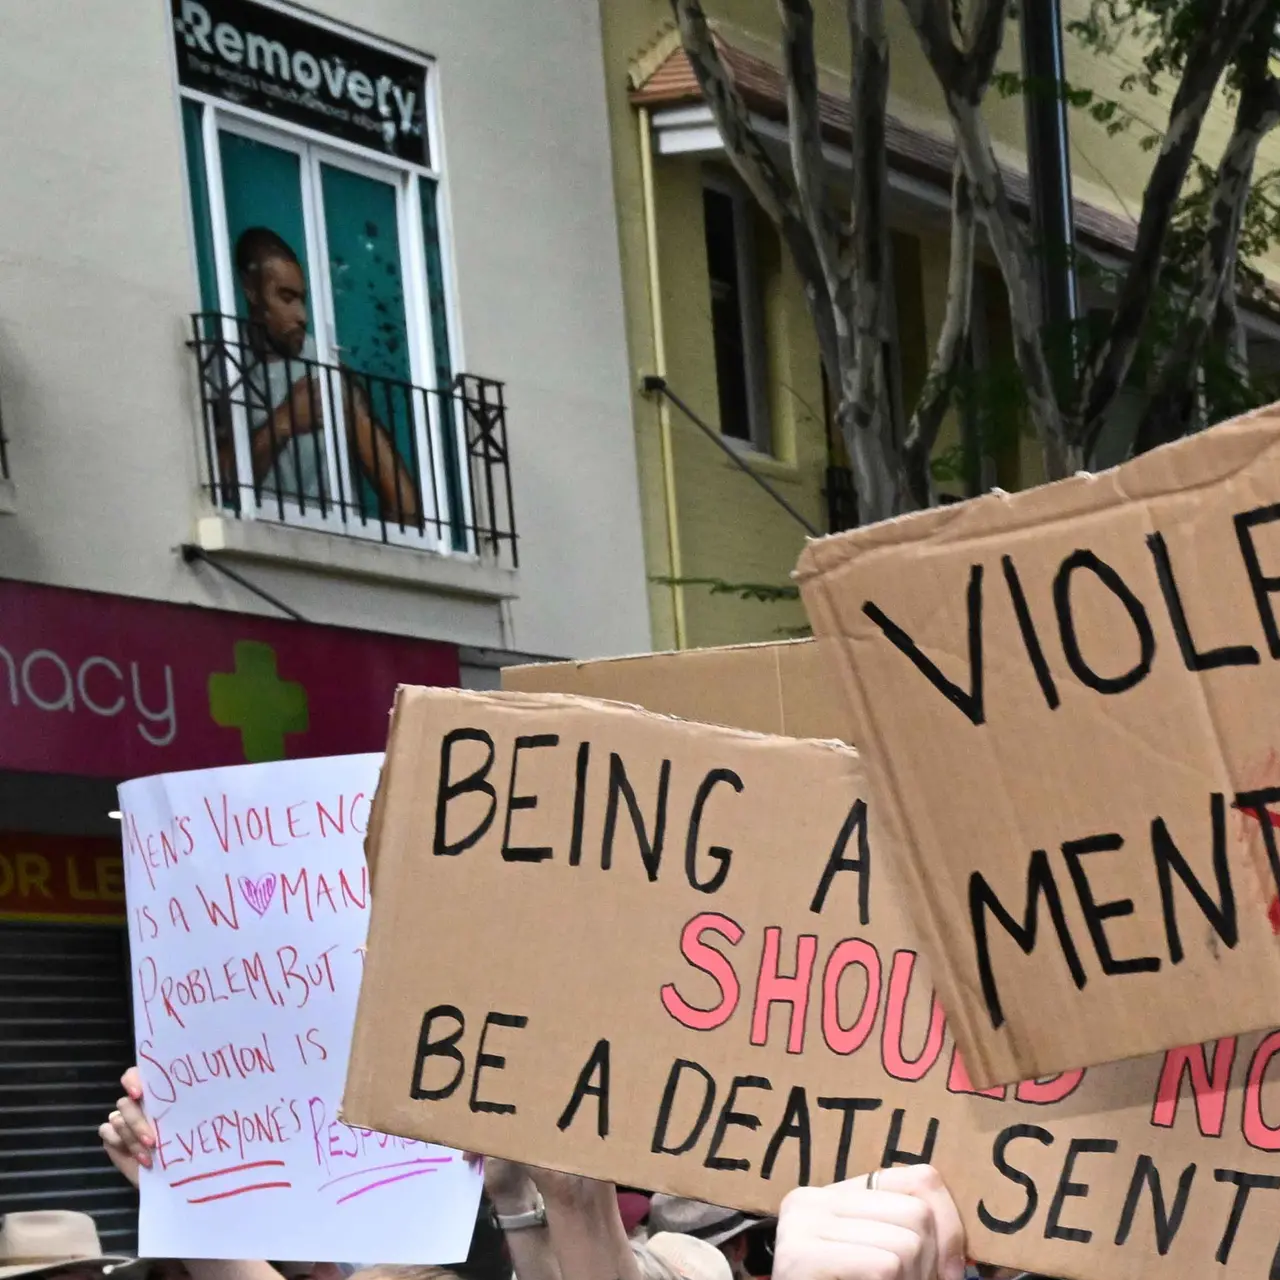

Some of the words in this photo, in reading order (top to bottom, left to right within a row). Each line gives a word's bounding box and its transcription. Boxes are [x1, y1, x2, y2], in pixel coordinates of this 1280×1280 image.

[174, 0, 416, 131] Removery
[204, 793, 367, 852] VIOLENC
[433, 727, 744, 895] BEING
[810, 799, 871, 925] A
[136, 905, 158, 942] IS
[169, 897, 190, 932] A
[139, 1033, 274, 1103] SOLUTION
[296, 1028, 327, 1065] IS
[410, 1004, 529, 1115] BE
[557, 1039, 609, 1139] A
[651, 1058, 939, 1188] DEATH
